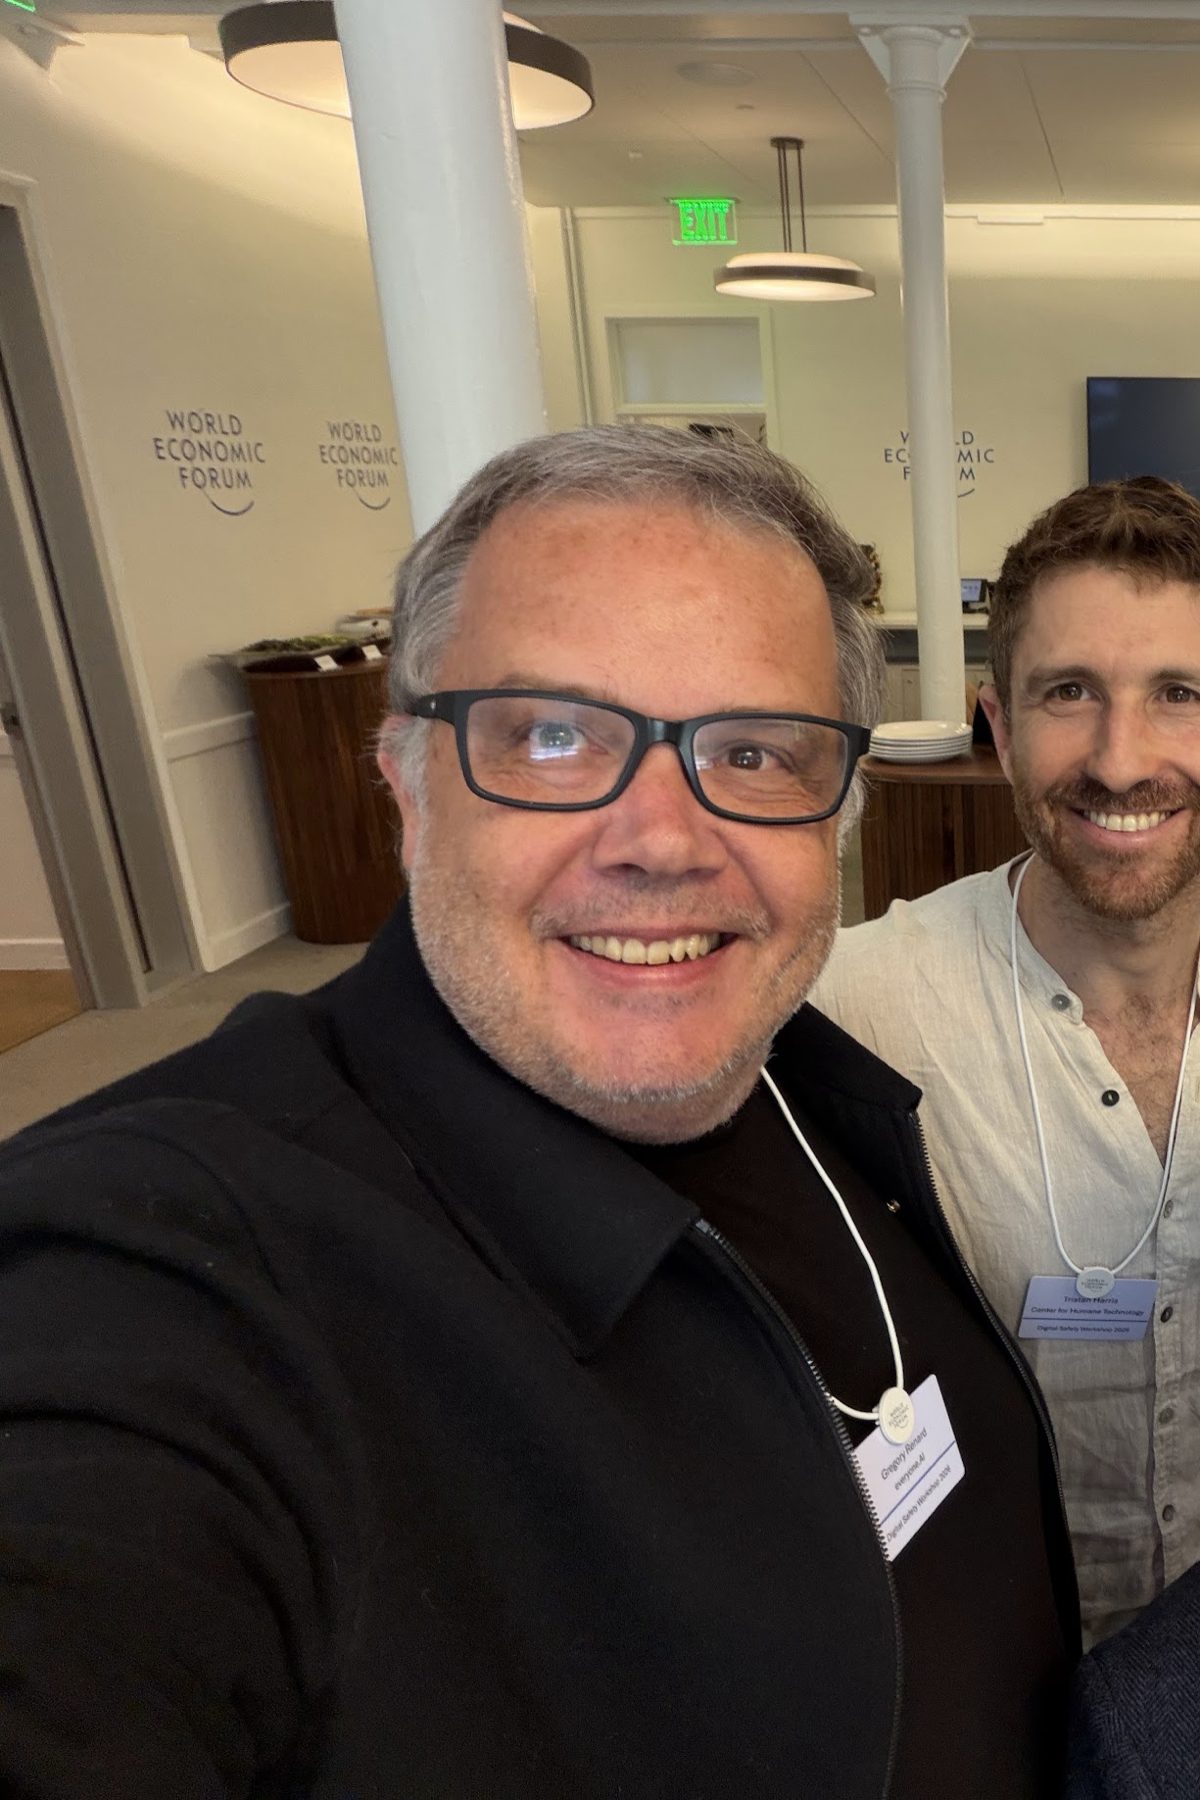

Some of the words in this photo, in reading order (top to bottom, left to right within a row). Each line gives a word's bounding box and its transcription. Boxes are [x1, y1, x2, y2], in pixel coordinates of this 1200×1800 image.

[680, 203, 728, 240] EXIT
[166, 409, 242, 435] WORLD
[327, 421, 382, 442] WORLD
[153, 437, 265, 463] ECONOMIC
[319, 444, 398, 465] ECONOMIC
[884, 448, 995, 463] ECMIC
[179, 466, 252, 489] FORUM
[336, 468, 389, 488] FORUM
[1103, 1309, 1144, 1317] Technology
[881, 1450, 907, 1480] Gregory
[905, 1427, 928, 1455] Renard
